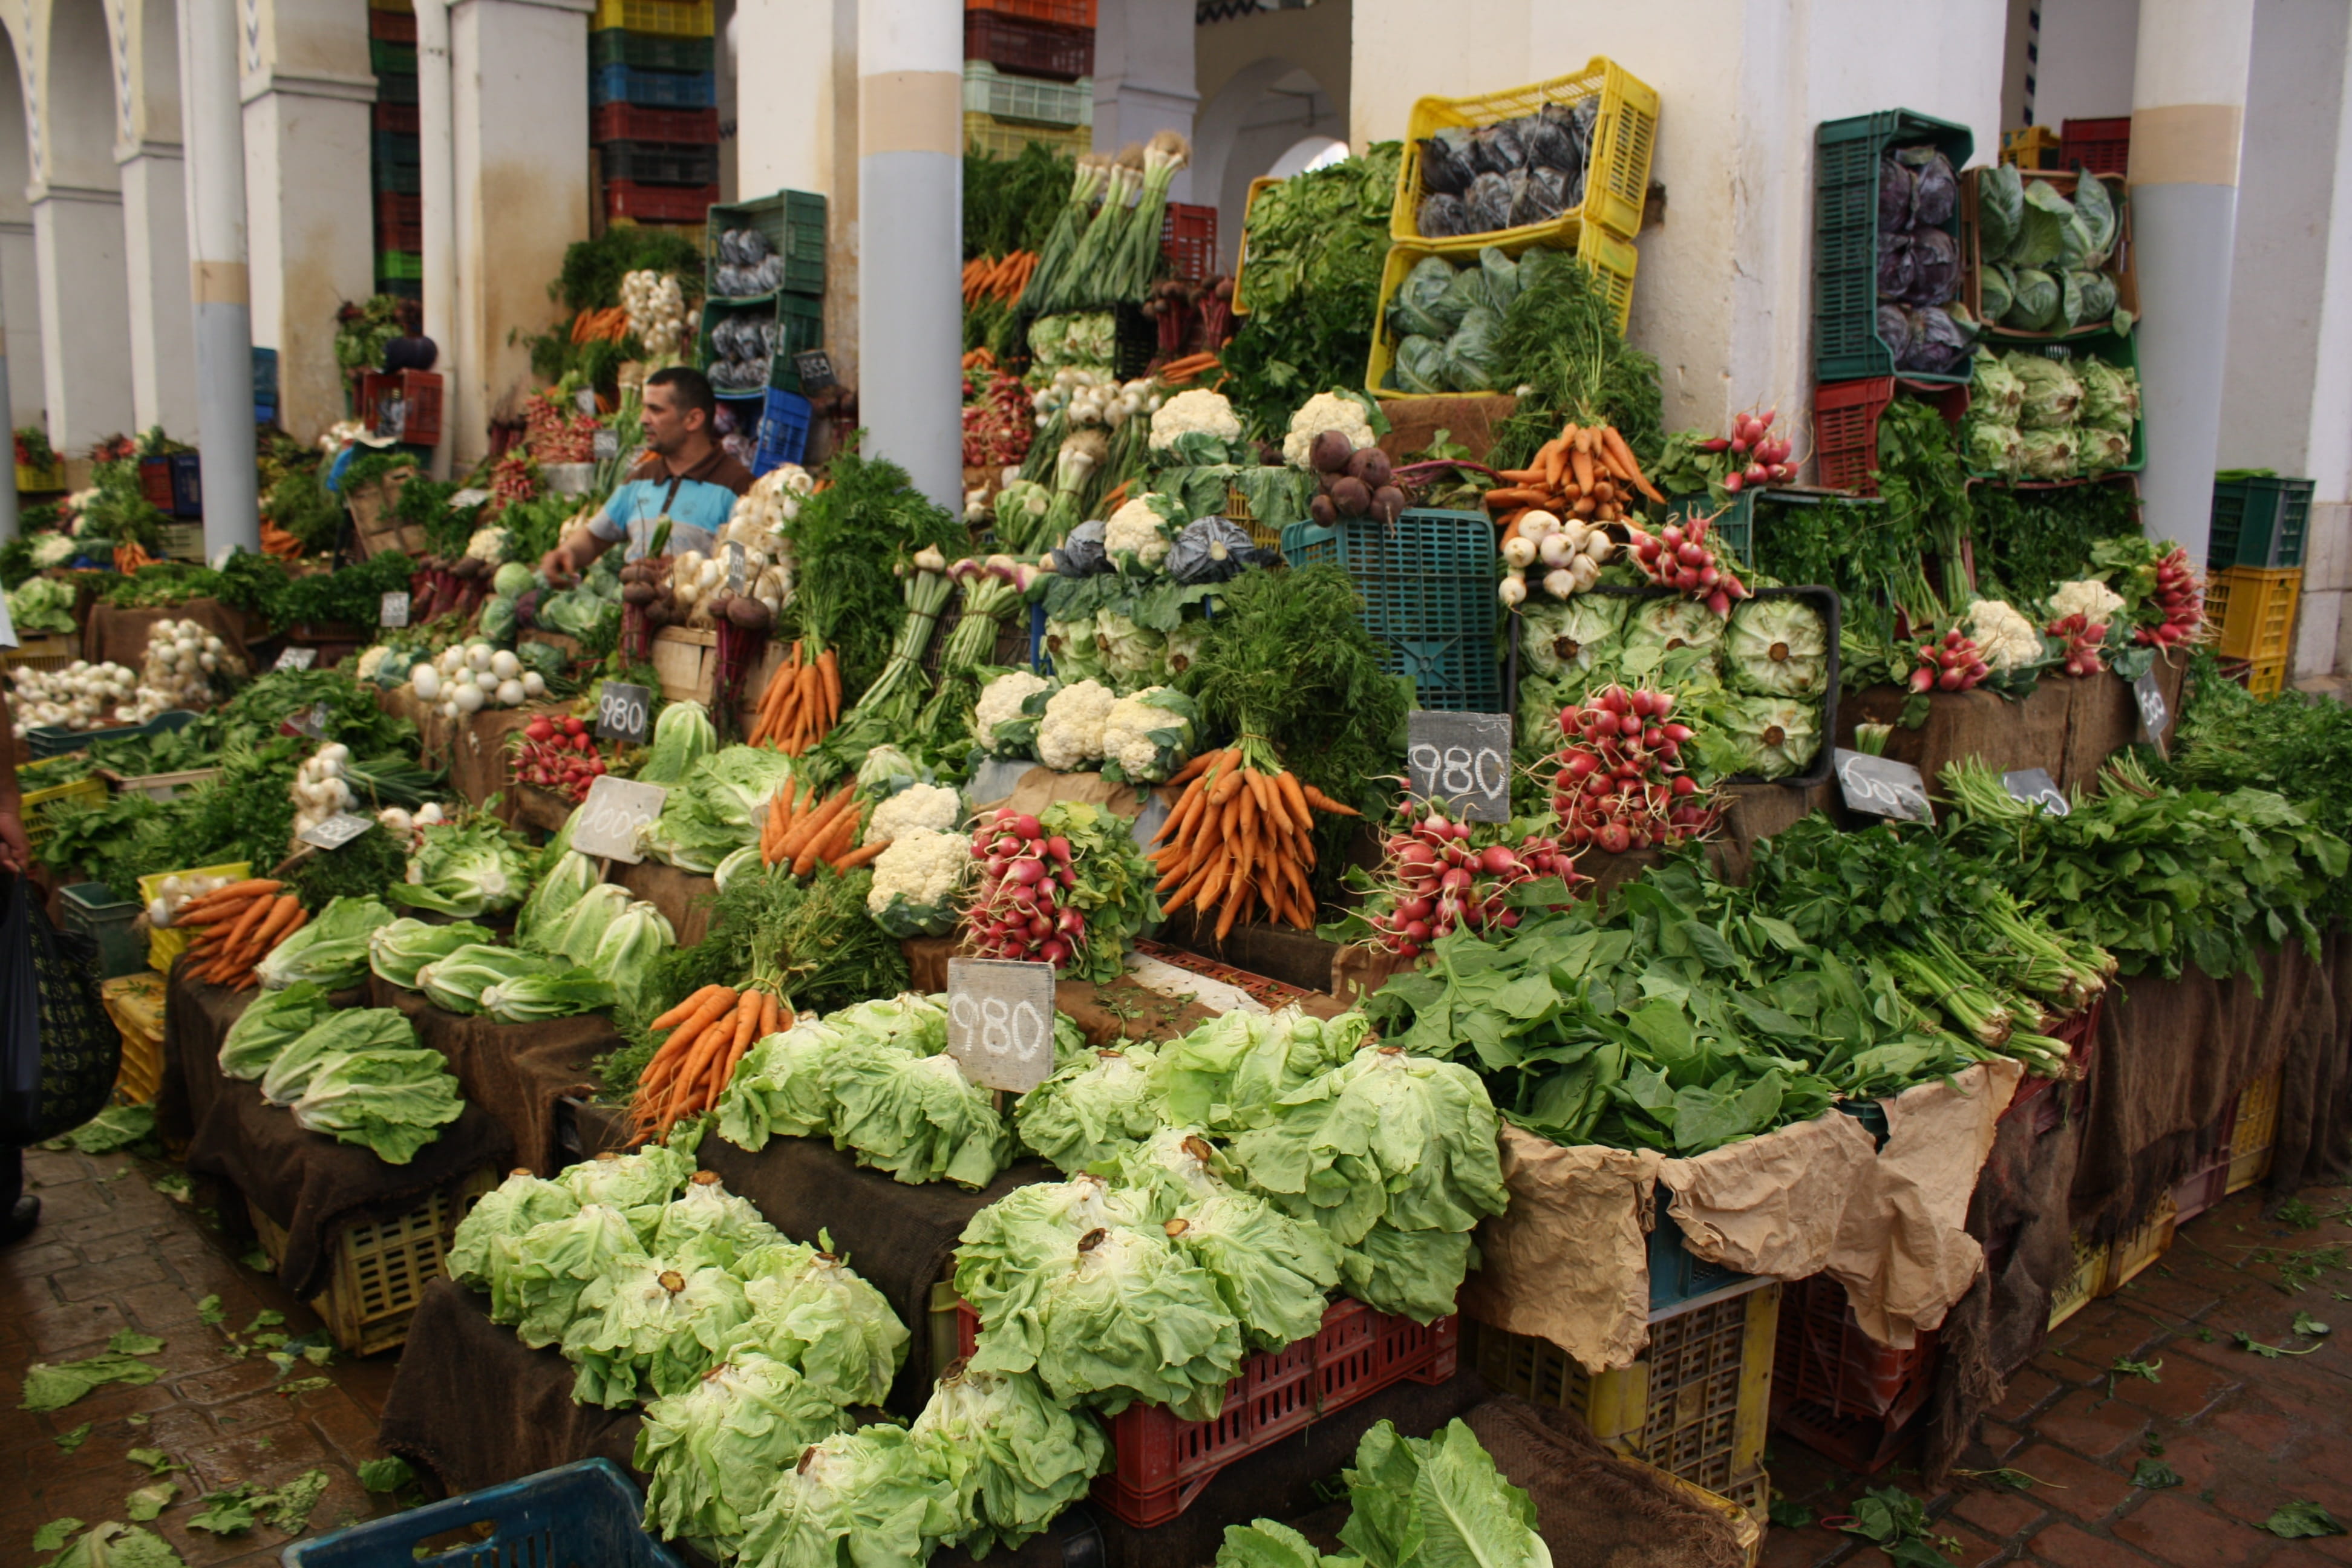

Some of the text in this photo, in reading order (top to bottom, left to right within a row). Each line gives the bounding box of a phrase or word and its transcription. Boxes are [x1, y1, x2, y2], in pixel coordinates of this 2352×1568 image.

[600, 694, 643, 734] 980
[1408, 743, 1506, 800] 980
[952, 991, 1045, 1062] 980
